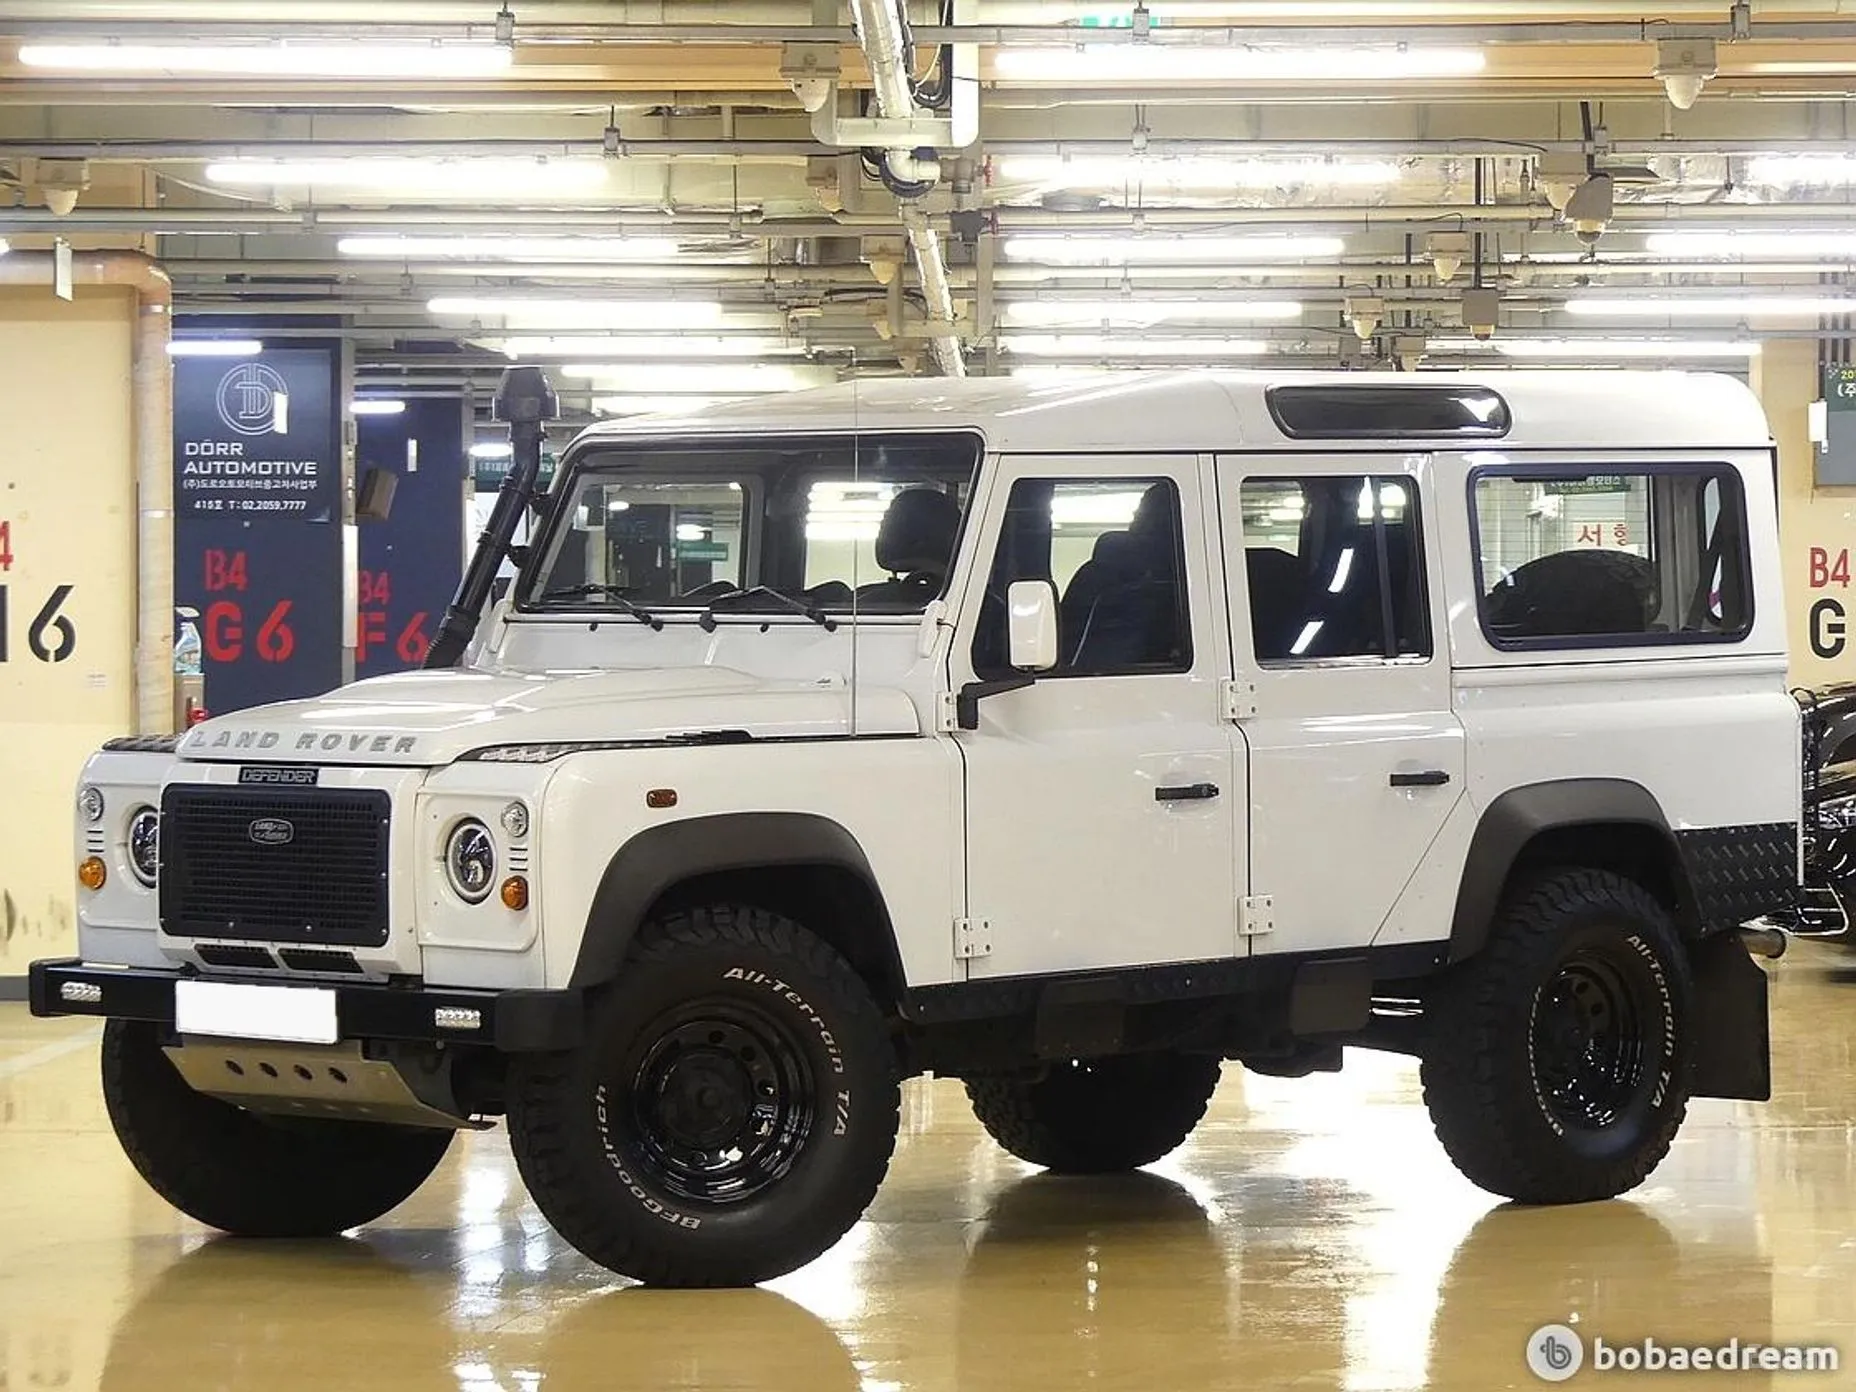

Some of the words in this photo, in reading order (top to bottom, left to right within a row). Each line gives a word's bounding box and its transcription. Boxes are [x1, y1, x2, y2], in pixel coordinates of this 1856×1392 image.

[185, 439, 243, 455] DÖRR
[184, 461, 317, 475] AUTOMOTIVE
[205, 549, 248, 591] B4
[1809, 547, 1850, 588] B4
[1809, 598, 1846, 659] G
[189, 731, 280, 750] LAND
[295, 732, 418, 754] ROVER
[241, 768, 317, 785] DEFENDER
[1625, 934, 1675, 1057] All-Terrain
[1652, 1070, 1672, 1108] T/A
[722, 967, 844, 1073] All-Terrain
[834, 1089, 851, 1135] T/A
[596, 1085, 701, 1230] BFGoodrich
